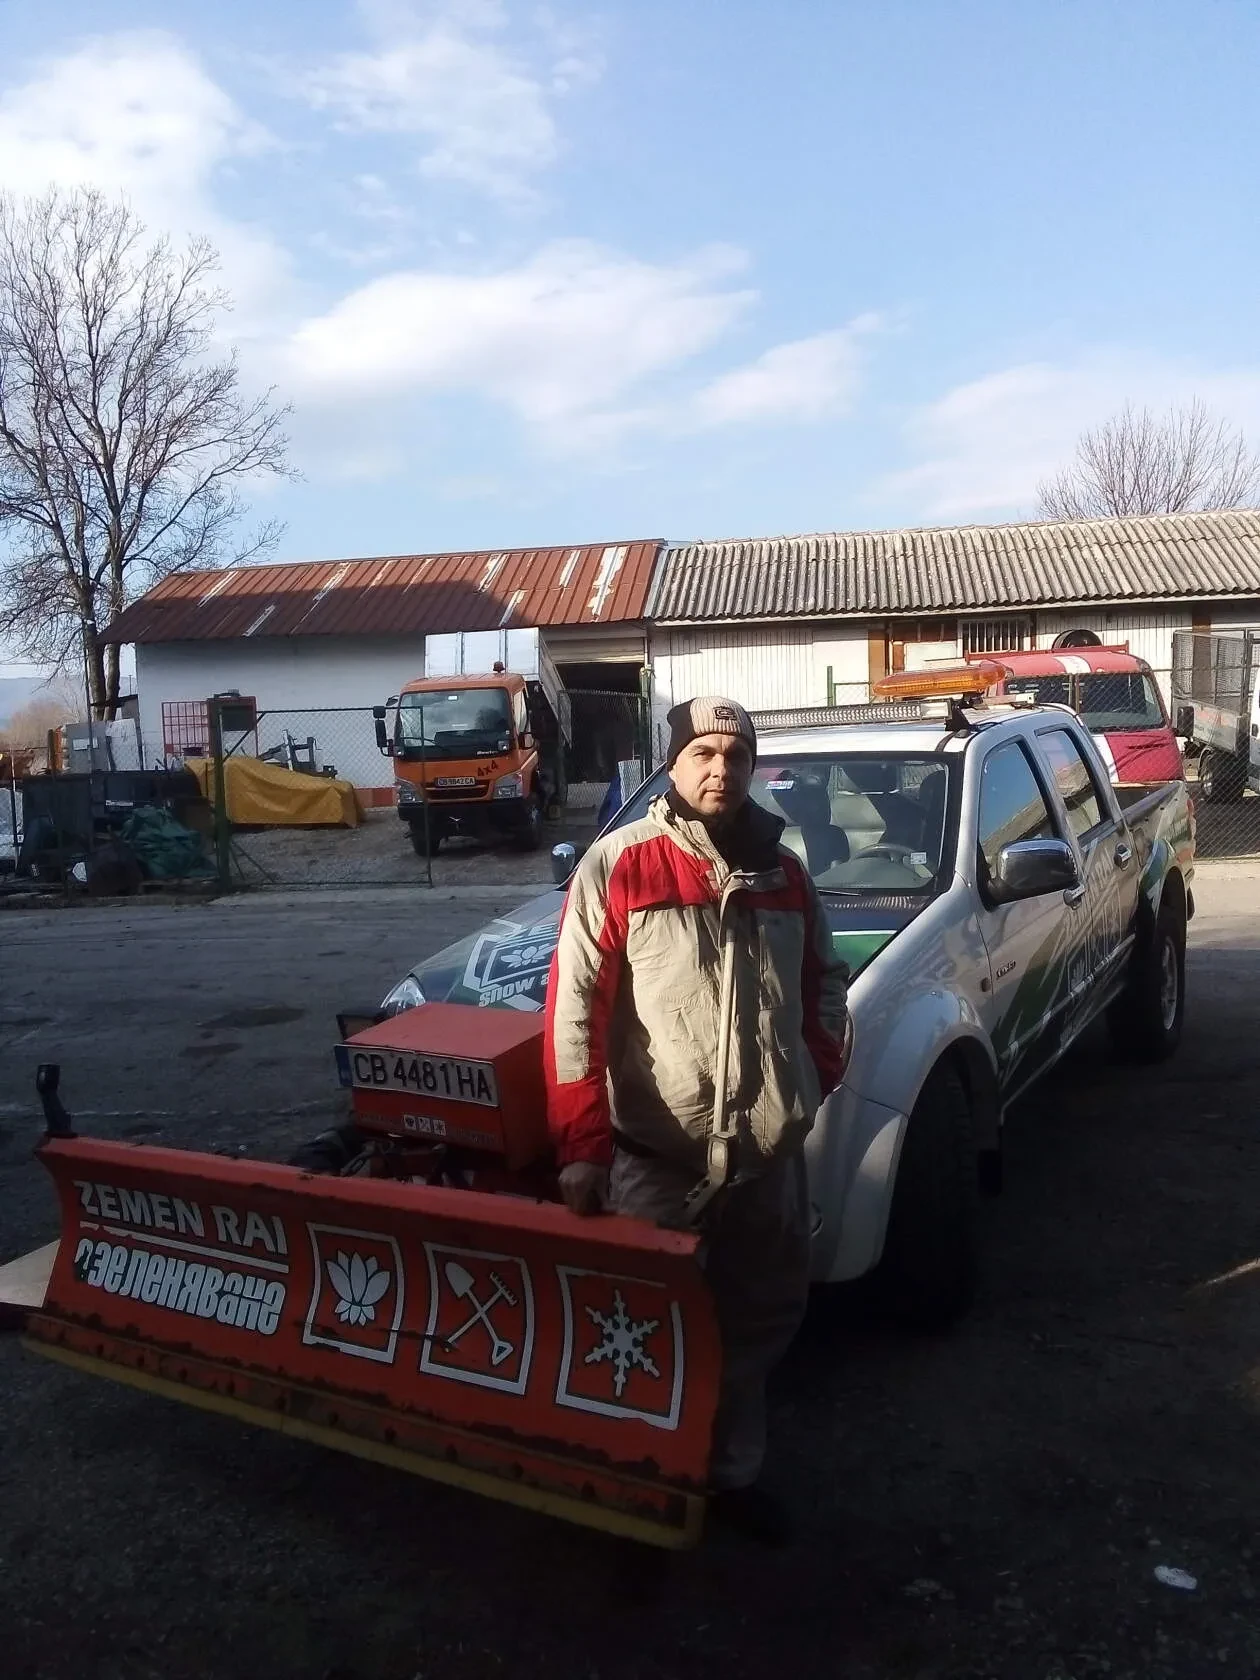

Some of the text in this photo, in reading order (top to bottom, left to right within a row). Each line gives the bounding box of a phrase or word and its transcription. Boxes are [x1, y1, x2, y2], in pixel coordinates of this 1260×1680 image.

[477, 760, 499, 776] 4x4
[72, 1179, 289, 1255] ZEMEN RAI
